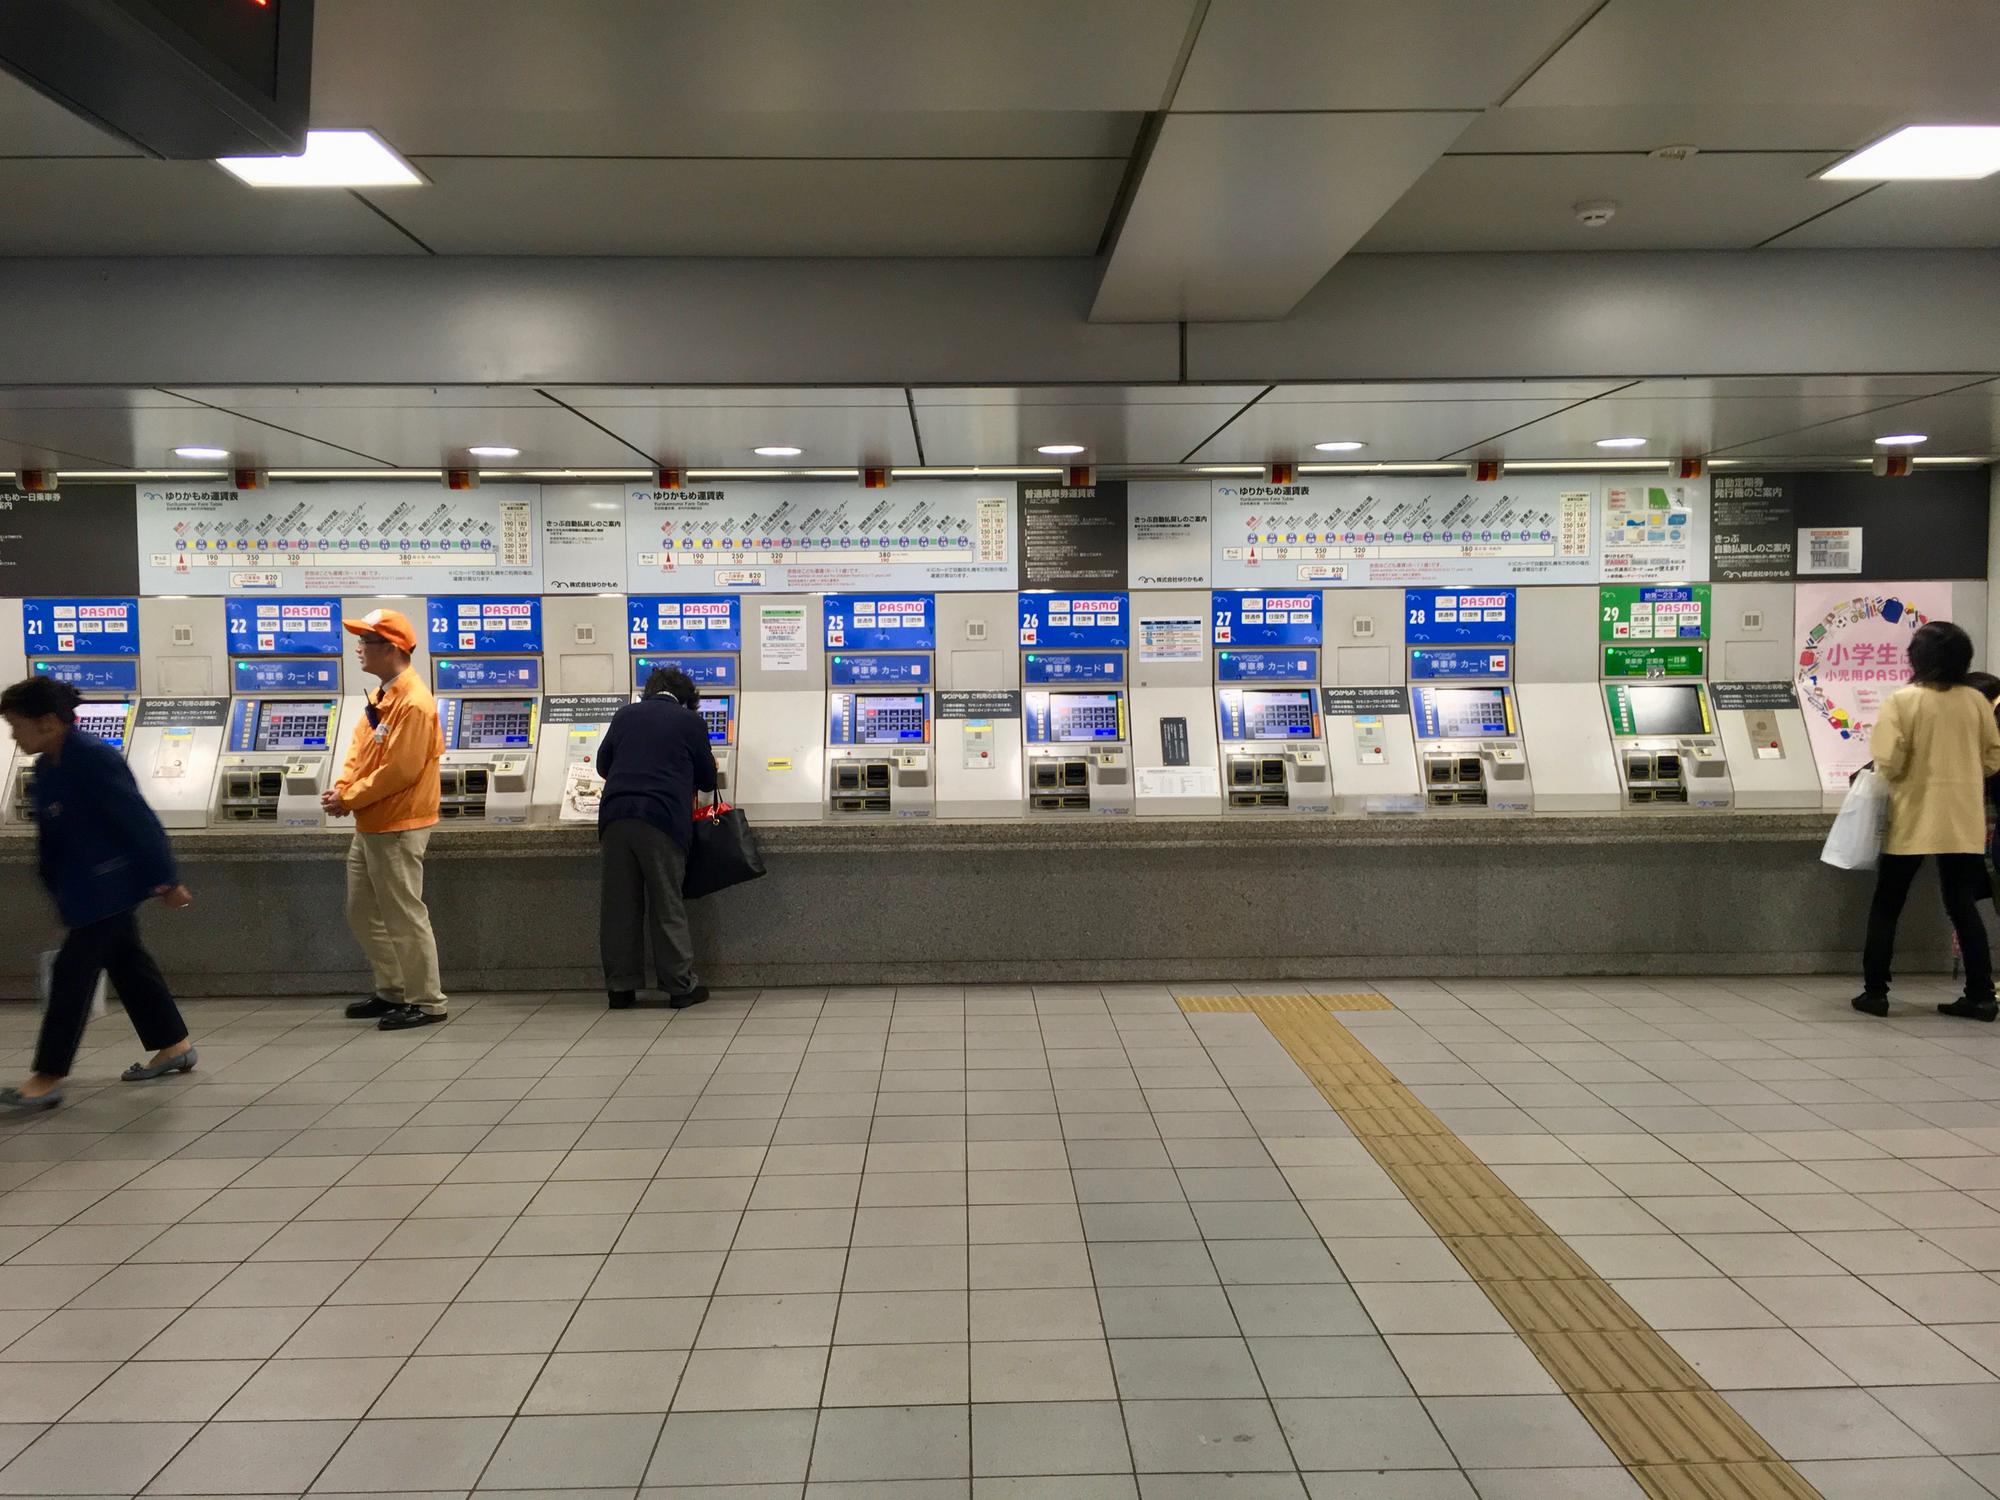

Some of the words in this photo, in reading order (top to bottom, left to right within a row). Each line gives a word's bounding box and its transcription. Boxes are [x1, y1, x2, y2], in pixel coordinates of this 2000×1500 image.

[1715, 478, 1764, 488] 自動定期券
[166, 492, 238, 500] ゆりかもめ運賃表
[654, 492, 724, 500] ゆりかもめ運賃表
[1239, 487, 1309, 496] ゆりかもめ運賃表
[1715, 488, 1782, 498] 発行機のご案内
[1715, 534, 1739, 543] きっぷ
[1714, 544, 1791, 553] 自動払戻しのご案内
[1074, 602, 1116, 610] PASMO
[1268, 600, 1310, 608] PASMO
[1461, 598, 1504, 606] PASMO
[284, 607, 328, 616] PASMO
[485, 606, 529, 614] PASMO
[684, 605, 728, 614] PASMO
[880, 603, 922, 611] PASMO
[1656, 604, 1700, 612] PASMO
[80, 608, 125, 616] PASMO
[1604, 607, 1619, 621] 29
[1023, 614, 1038, 628] 26
[1216, 612, 1231, 625] 27
[1410, 610, 1425, 624] 28
[28, 620, 42, 634] 21
[231, 619, 247, 633] 22
[432, 618, 448, 632] 23
[633, 618, 648, 632] 24
[829, 616, 844, 630] 25
[1075, 664, 1101, 672] カード
[1268, 662, 1294, 670] カード
[1461, 660, 1486, 668] カード
[489, 670, 515, 679] カード
[687, 668, 713, 676] カード
[882, 666, 908, 674] カード
[86, 672, 113, 680] カード
[288, 672, 314, 680] カード
[1826, 669, 1914, 681] 小児用PASM
